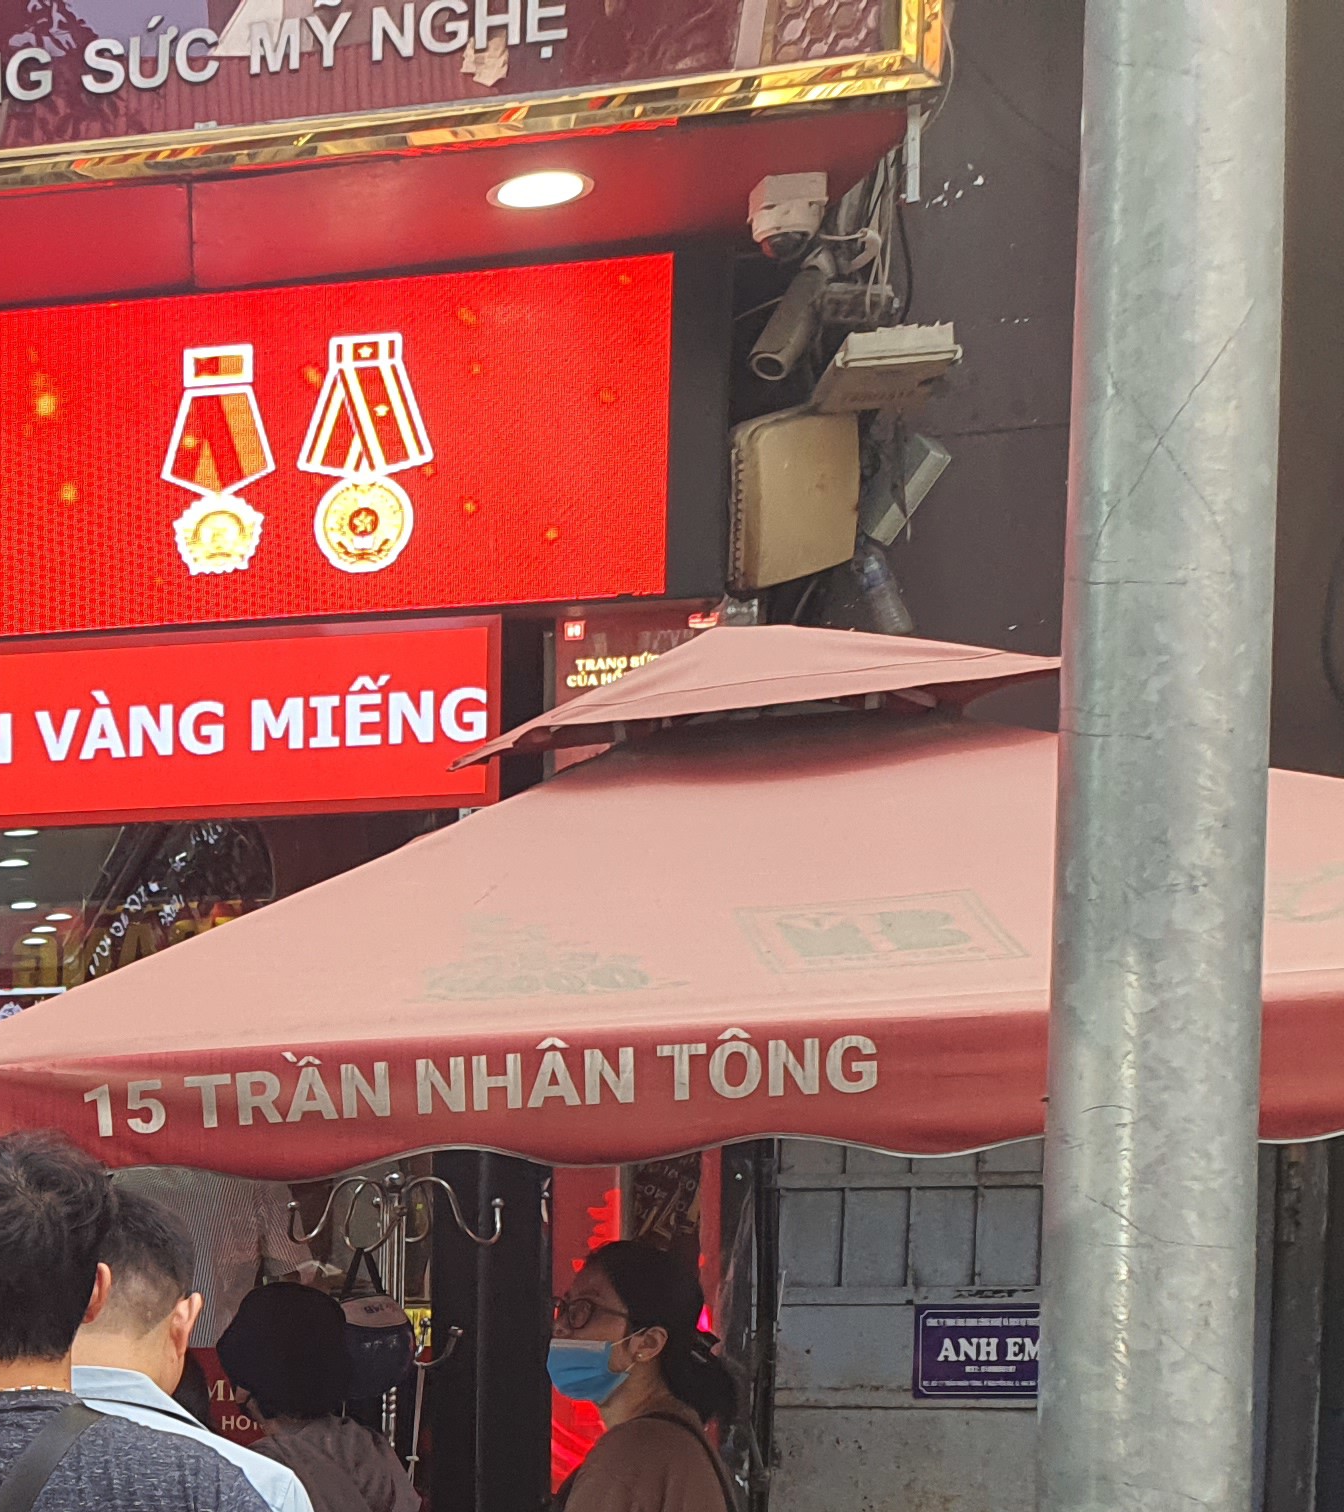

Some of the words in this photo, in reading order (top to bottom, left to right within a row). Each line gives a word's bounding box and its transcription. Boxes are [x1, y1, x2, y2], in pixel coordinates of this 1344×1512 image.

[81, 22, 220, 96] SỨC
[35, 691, 226, 761] VÀNG
[250, 675, 488, 752] MIẾNG
[83, 1077, 169, 1137] 15
[184, 1051, 392, 1129] TRẦN
[416, 1036, 636, 1115] NHÂN
[657, 1026, 880, 1103] TÔNG
[937, 1337, 999, 1362] ANH
